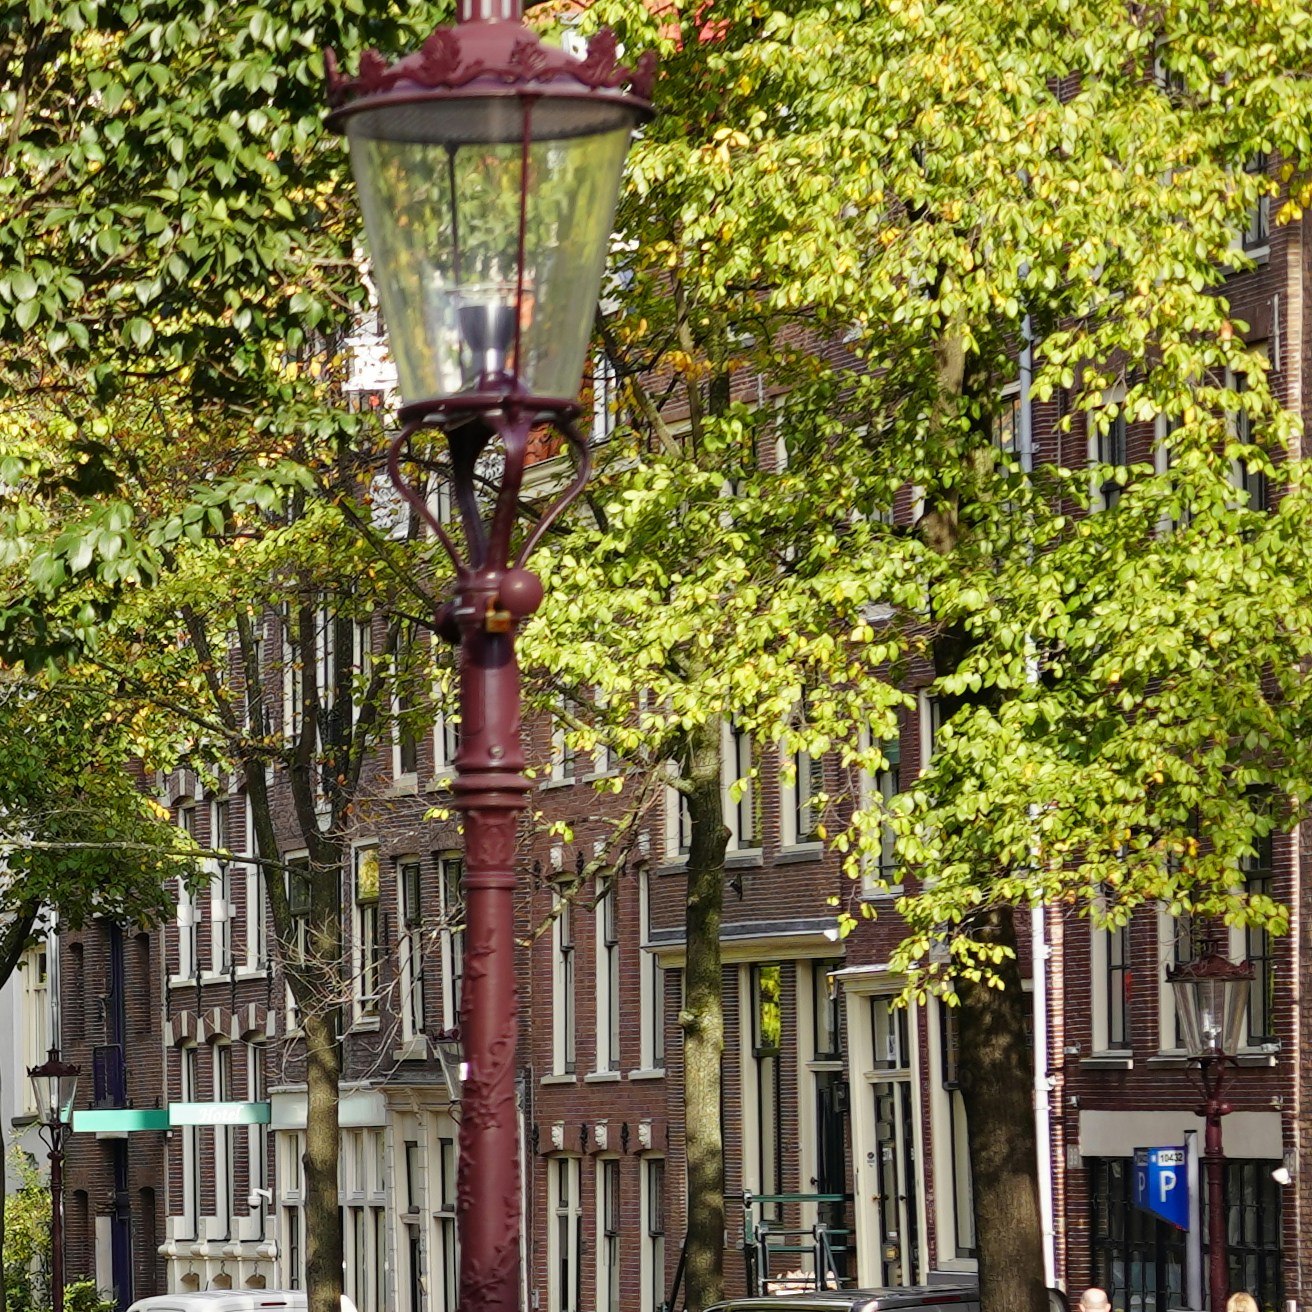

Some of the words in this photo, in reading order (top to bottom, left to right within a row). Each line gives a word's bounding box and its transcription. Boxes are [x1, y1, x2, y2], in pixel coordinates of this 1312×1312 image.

[199, 1104, 245, 1123] Hotel
[1160, 1152, 1184, 1163] 10432
[1159, 1170, 1177, 1203] P
